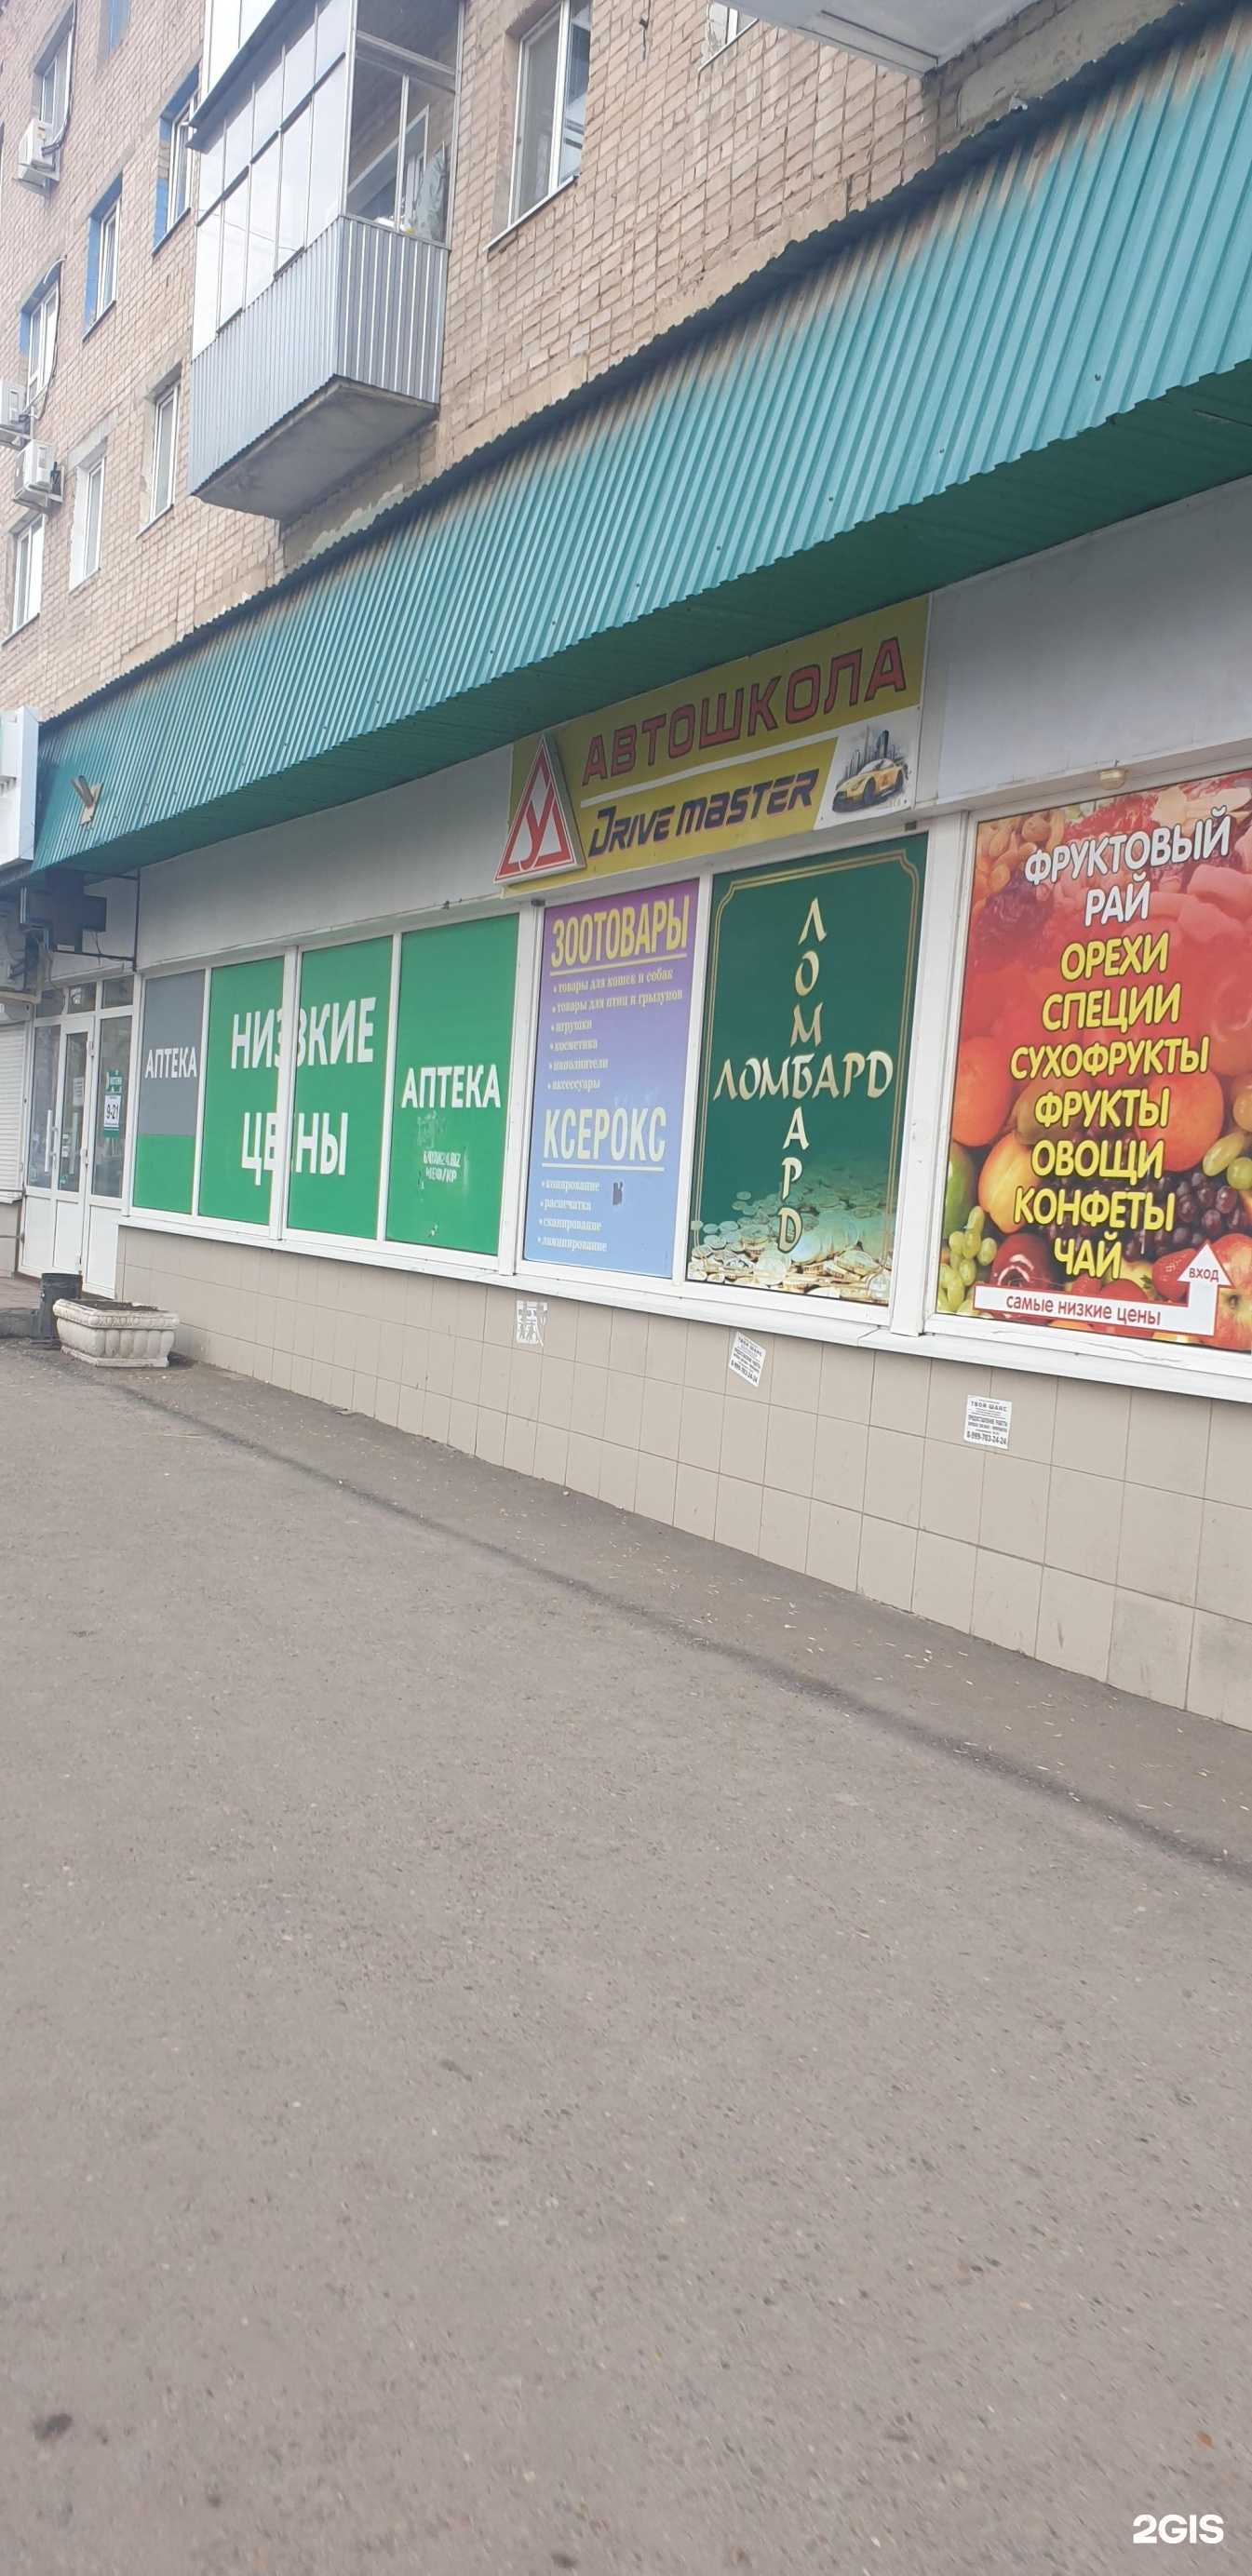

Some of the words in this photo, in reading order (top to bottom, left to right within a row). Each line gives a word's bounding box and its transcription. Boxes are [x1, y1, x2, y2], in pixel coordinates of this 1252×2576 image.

[581, 637, 908, 785] АВТОШКОЛА
[1025, 806, 1232, 884] ФРУКТОВЫЙ
[1084, 871, 1151, 927] РАЙ
[551, 895, 690, 967] ЗООТОВАРЫ
[1060, 932, 1169, 981] ОРЕХИ
[1042, 983, 1181, 1033] СПЕЦИИ
[144, 1046, 197, 1079] АПТЕКА
[713, 1051, 894, 1101] ЛОМБАРД
[778, 897, 828, 1254] ЛОМБАРД
[1010, 1036, 1210, 1080] СУХОФРУКТЫ
[401, 1064, 502, 1108] АПТЕКА
[1034, 1087, 1171, 1128] ФРУКТЫ
[241, 1112, 349, 1186] ЦЕНЫ
[543, 1106, 666, 1162] КСЕРОКС
[1031, 1139, 1164, 1187] ОВОЩИ
[1014, 1187, 1176, 1232] КОНФЕТЫ
[1054, 1230, 1123, 1279] ЧАЙ
[1006, 1294, 1054, 1313] самые
[1057, 1300, 1112, 1320] низкие
[1117, 1308, 1161, 1326] цены
